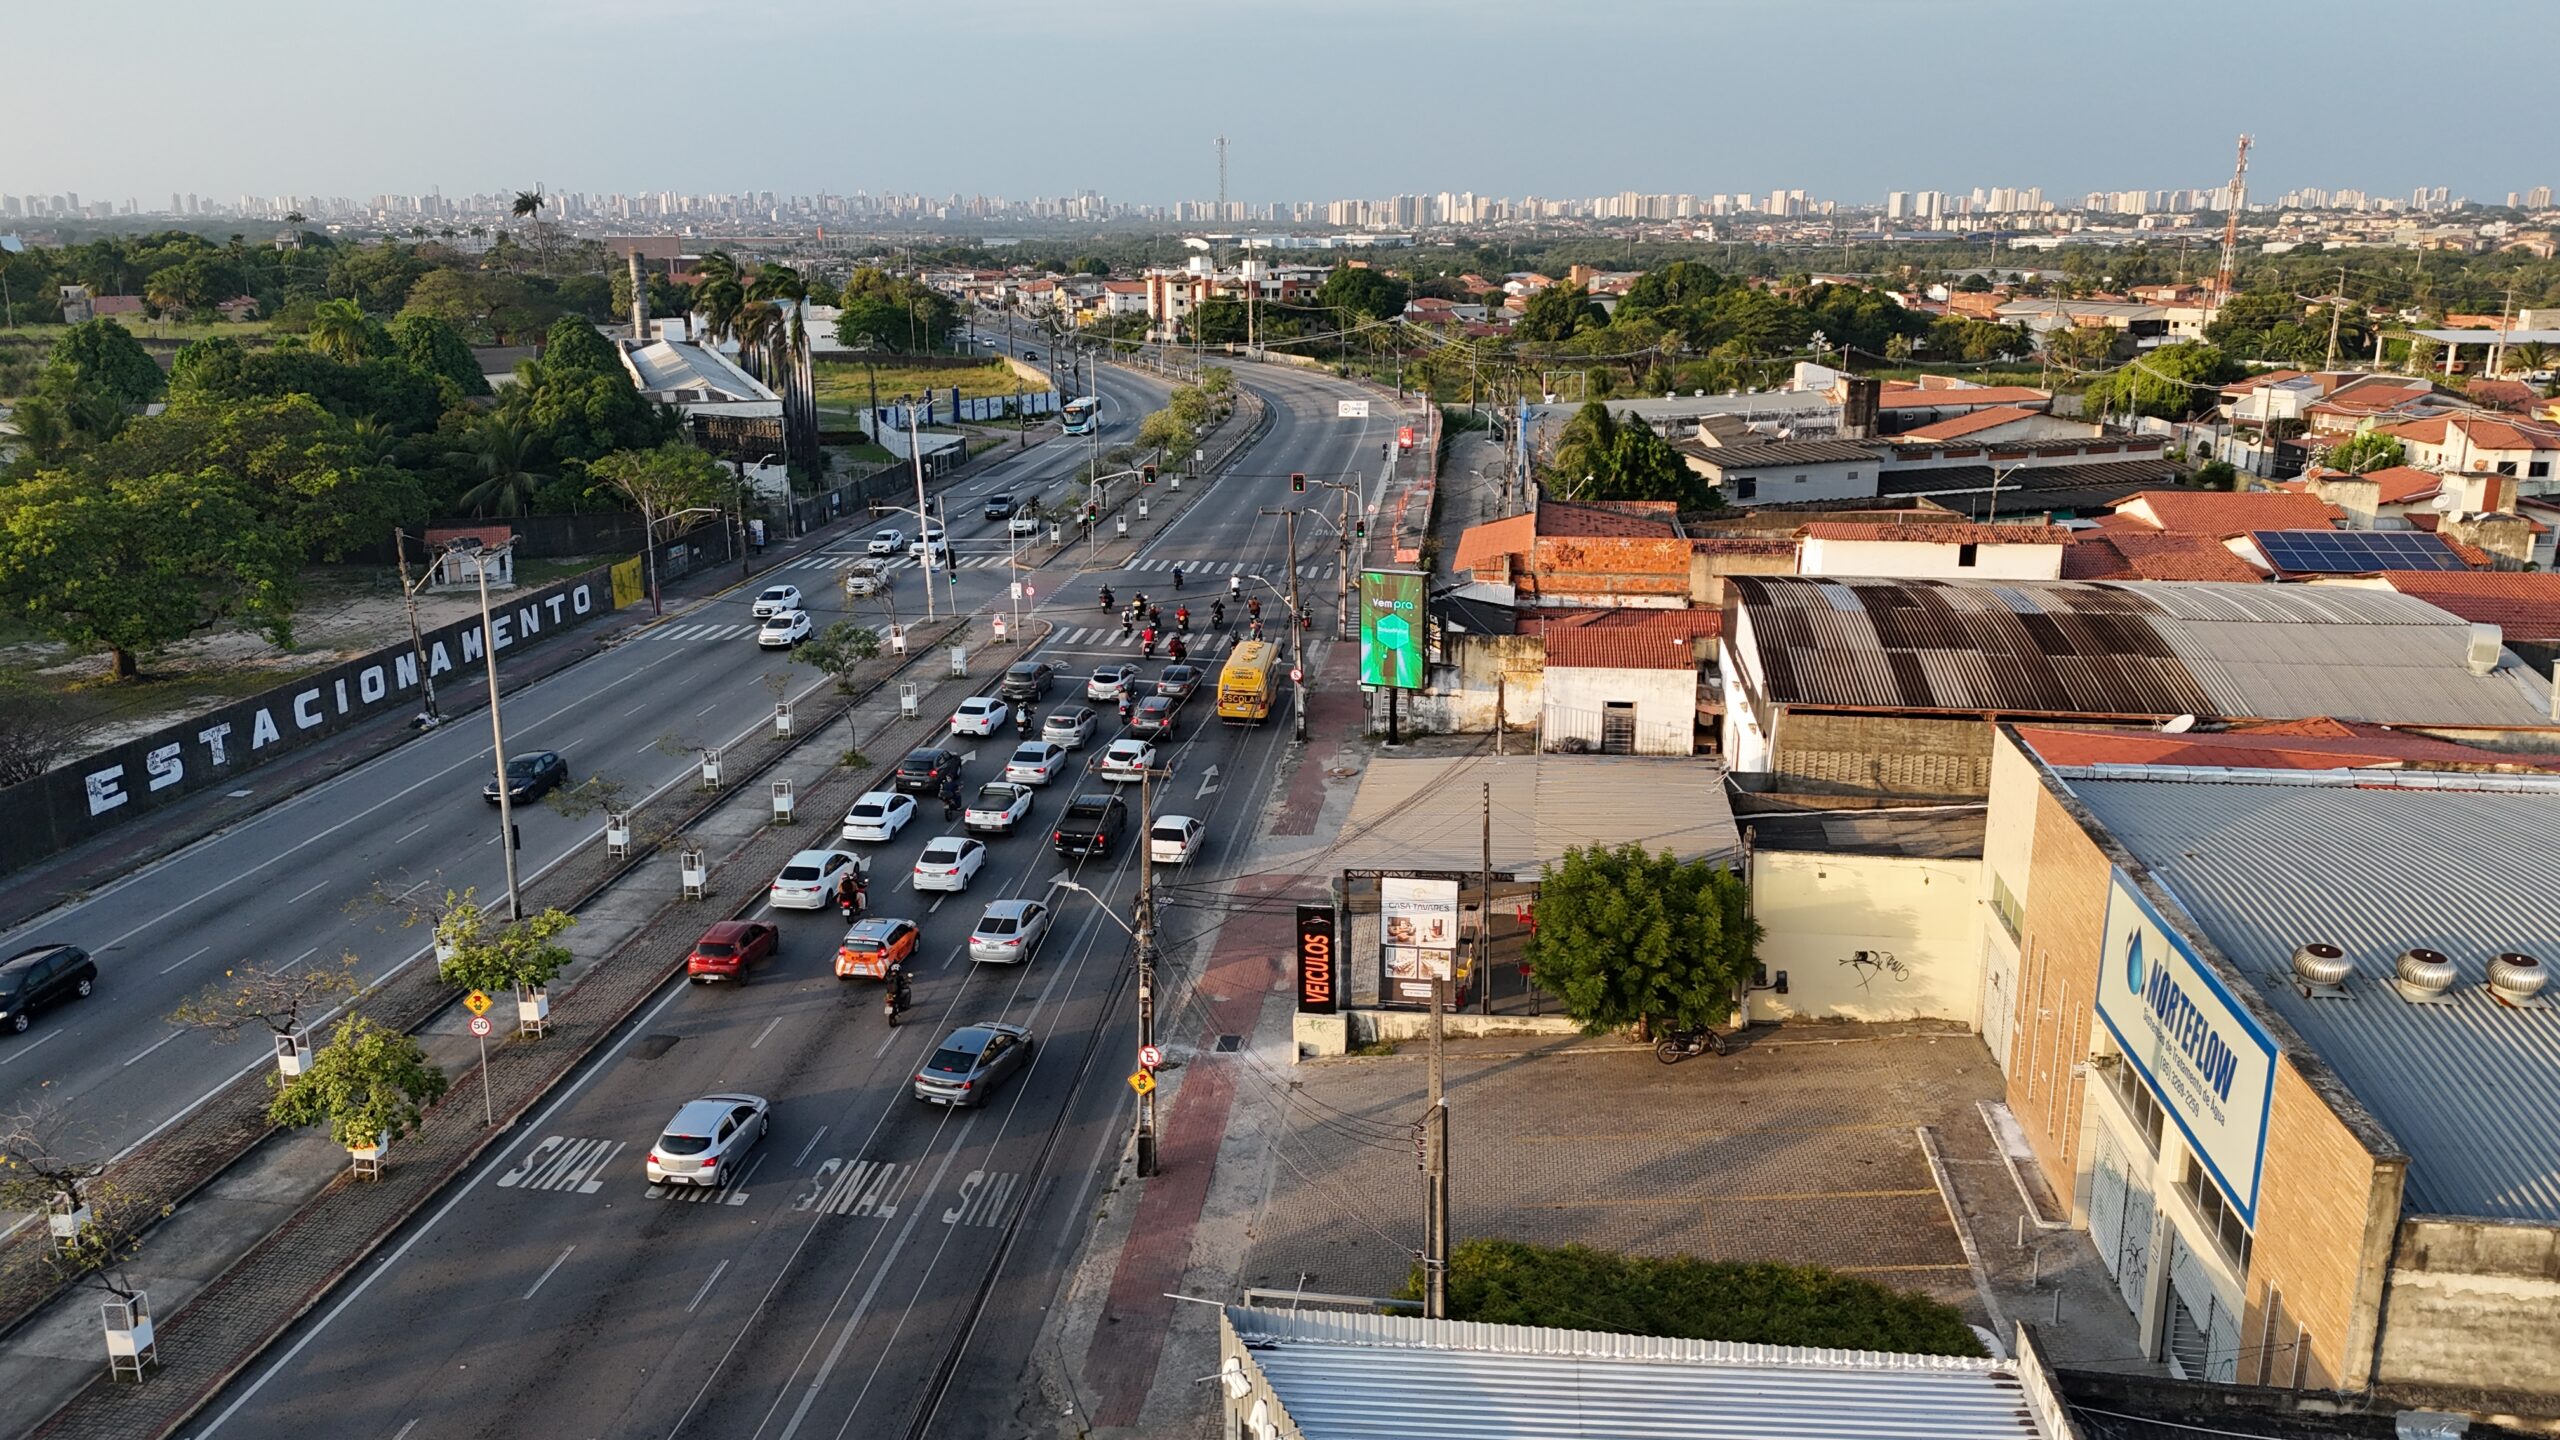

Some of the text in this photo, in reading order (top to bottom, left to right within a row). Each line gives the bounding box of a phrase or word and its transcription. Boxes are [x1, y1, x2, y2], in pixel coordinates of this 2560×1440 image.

[1372, 598, 1414, 611] Vem pra
[85, 583, 593, 817] ESTACIONAMENTO
[1388, 902, 1450, 912] CASA TAVARES
[1304, 934, 1330, 1003] VEICULOS
[473, 1020, 488, 1030] 50
[2146, 958, 2238, 1104] NORTEFLOW
[2165, 1037, 2173, 1056] de
[2172, 1044, 2203, 1096] Tratamento
[2202, 1088, 2211, 1107] de
[2209, 1095, 2225, 1127] Água
[496, 1135, 627, 1195] SINAL
[793, 1157, 911, 1218] SINAL
